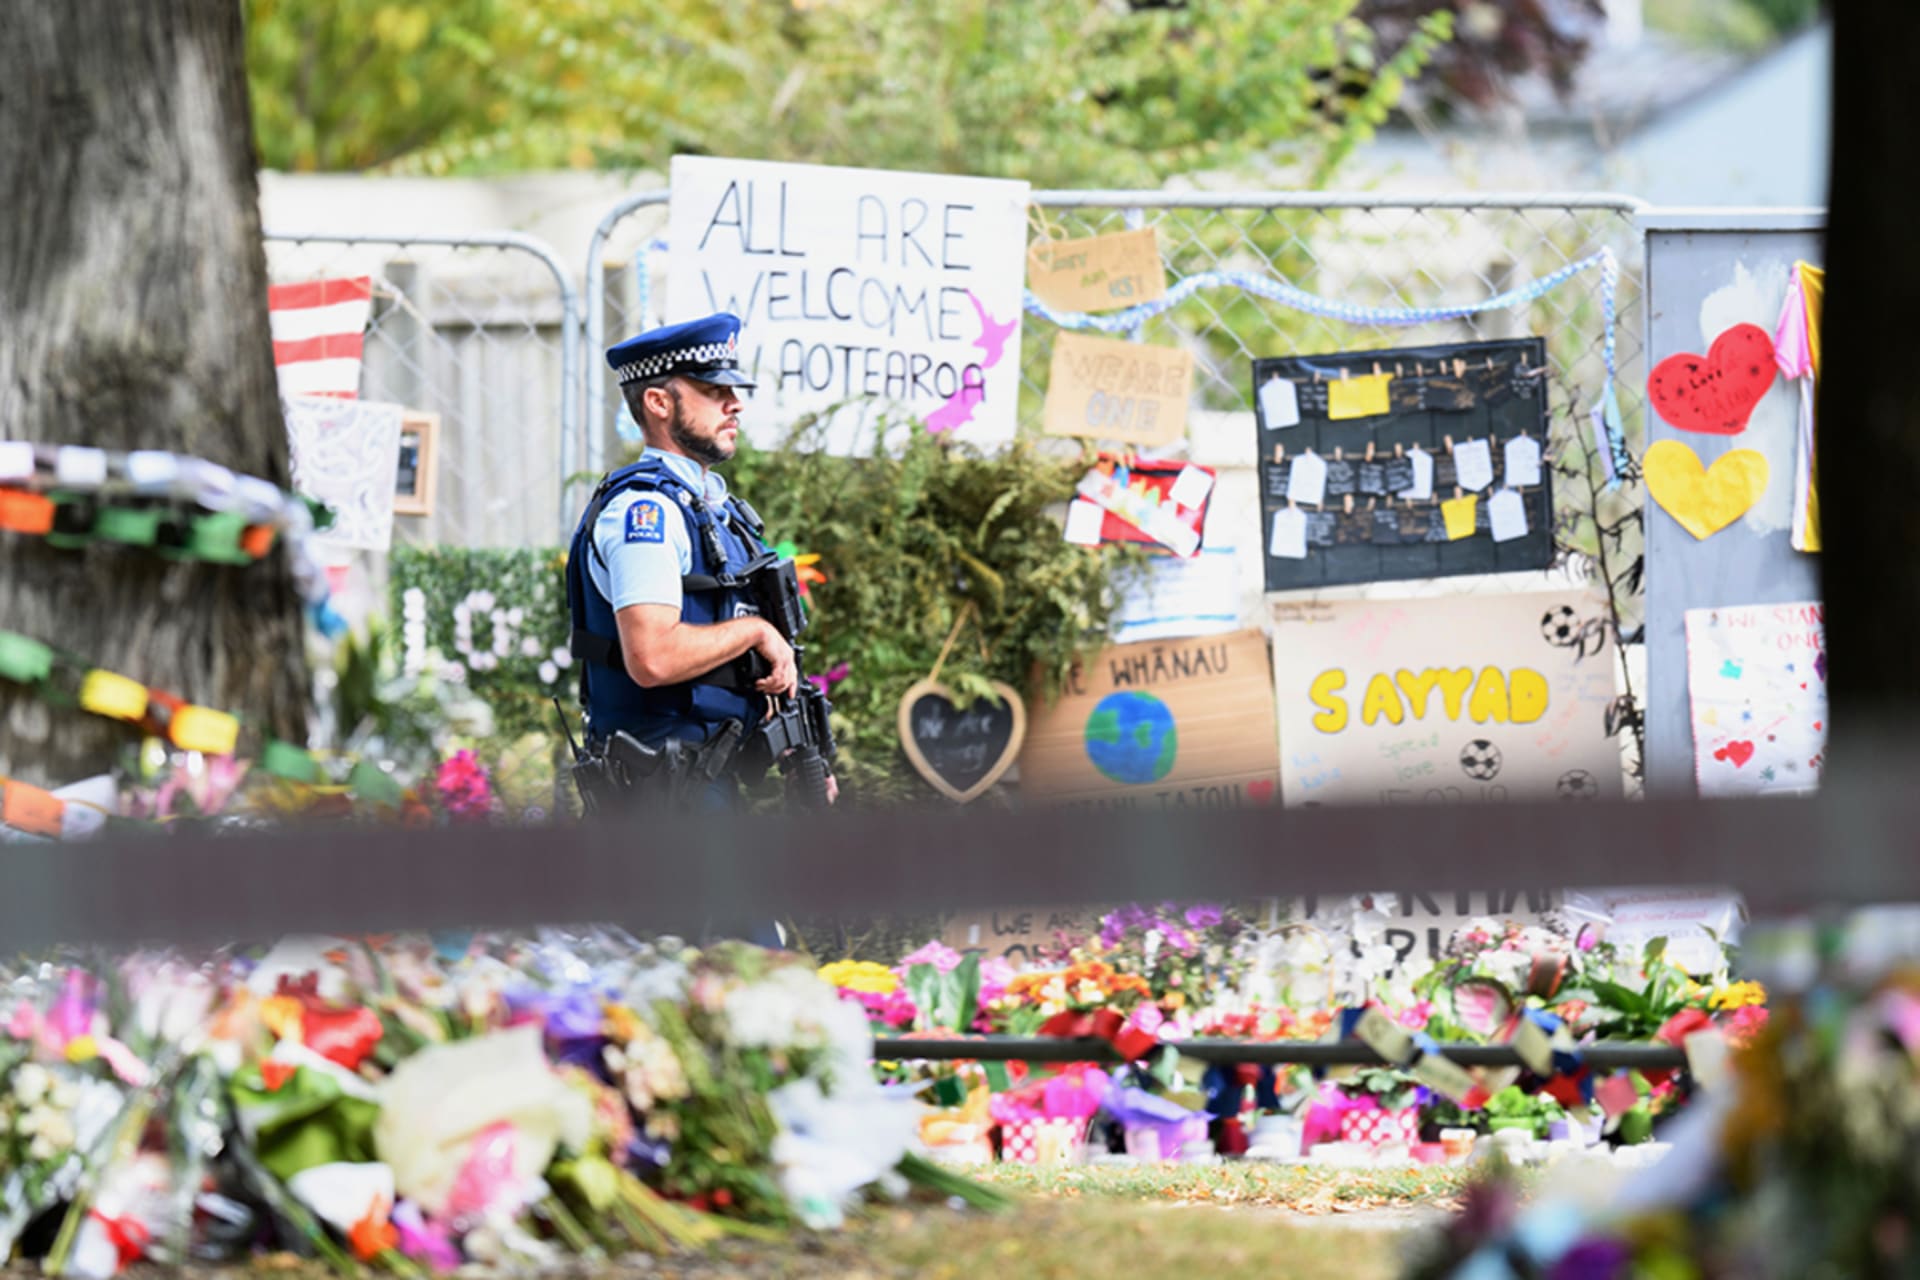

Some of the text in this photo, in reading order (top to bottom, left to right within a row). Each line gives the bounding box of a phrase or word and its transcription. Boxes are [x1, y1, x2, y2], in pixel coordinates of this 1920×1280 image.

[698, 179, 975, 271] ALL ARE
[702, 266, 972, 343] WELCOME
[779, 338, 987, 402] AOTEAROA
[1086, 388, 1161, 432] ONE
[1109, 643, 1229, 687] WHĀNAU
[1309, 665, 1550, 735] SAYYAD
